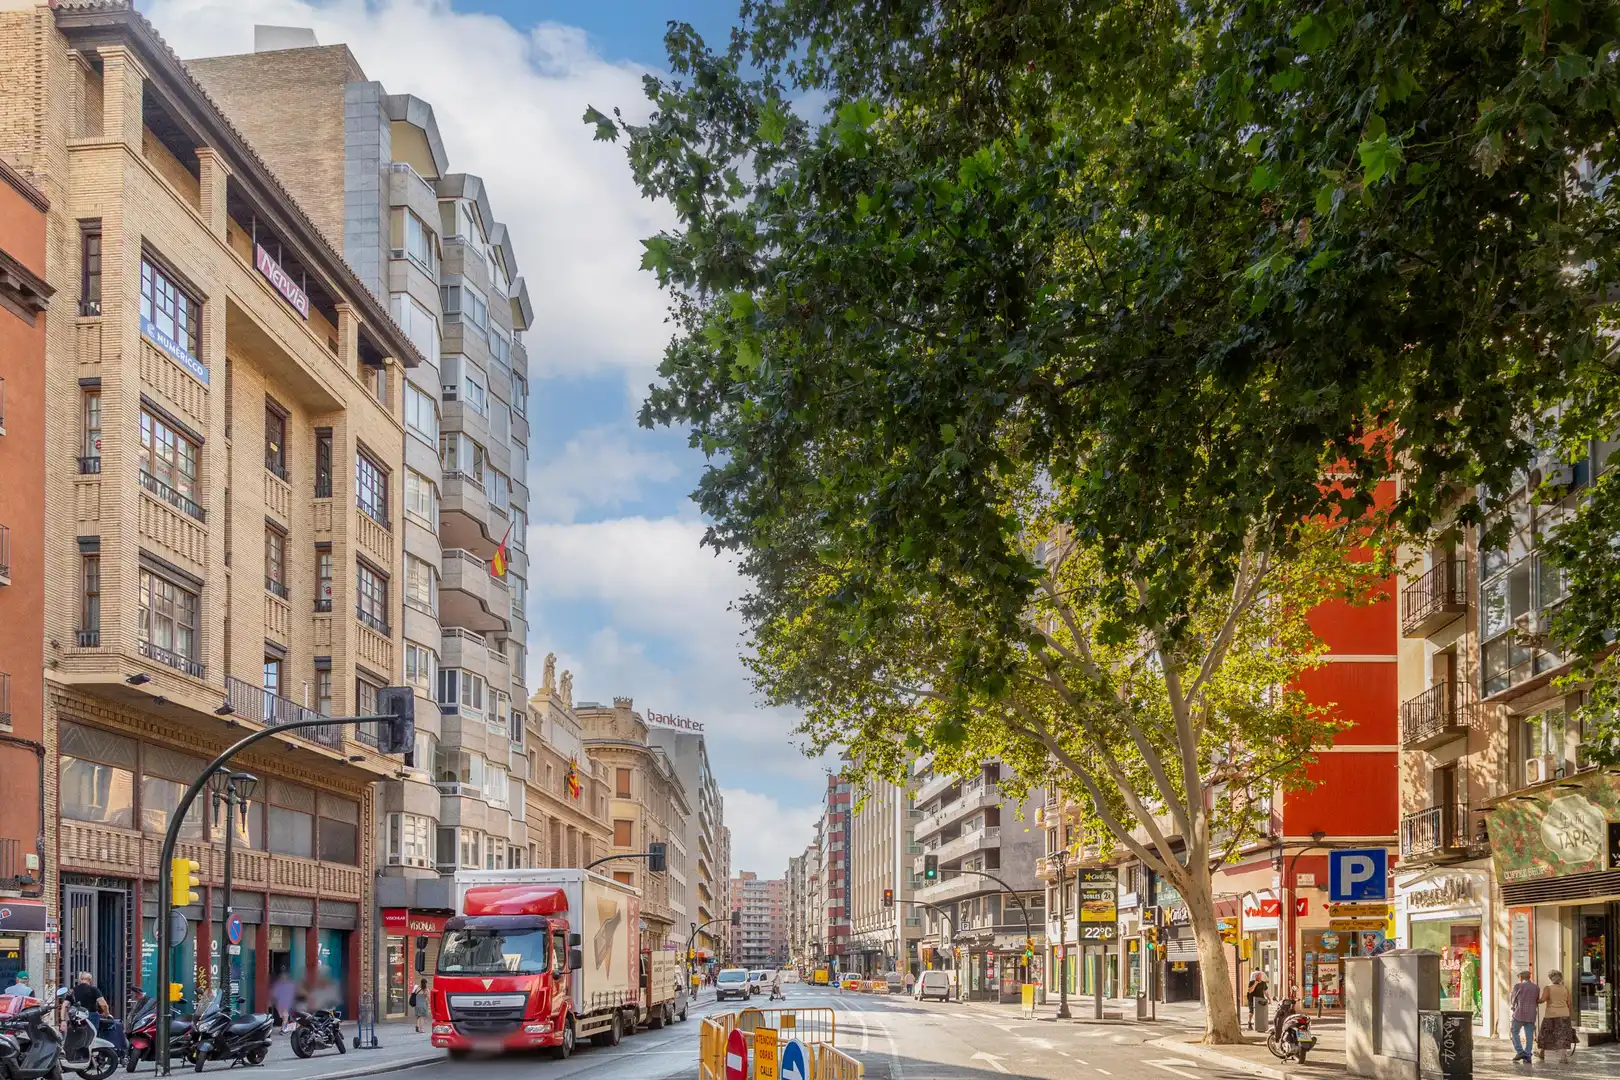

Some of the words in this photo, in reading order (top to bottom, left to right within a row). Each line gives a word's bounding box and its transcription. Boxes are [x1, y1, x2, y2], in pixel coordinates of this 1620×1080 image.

[261, 253, 306, 313] Nervia
[1556, 828, 1592, 850] TAPA
[1340, 855, 1375, 896] P
[410, 920, 436, 932] VISIONLAB
[759, 1049, 773, 1061] OBRAS
[760, 1065, 773, 1078] CALLE
